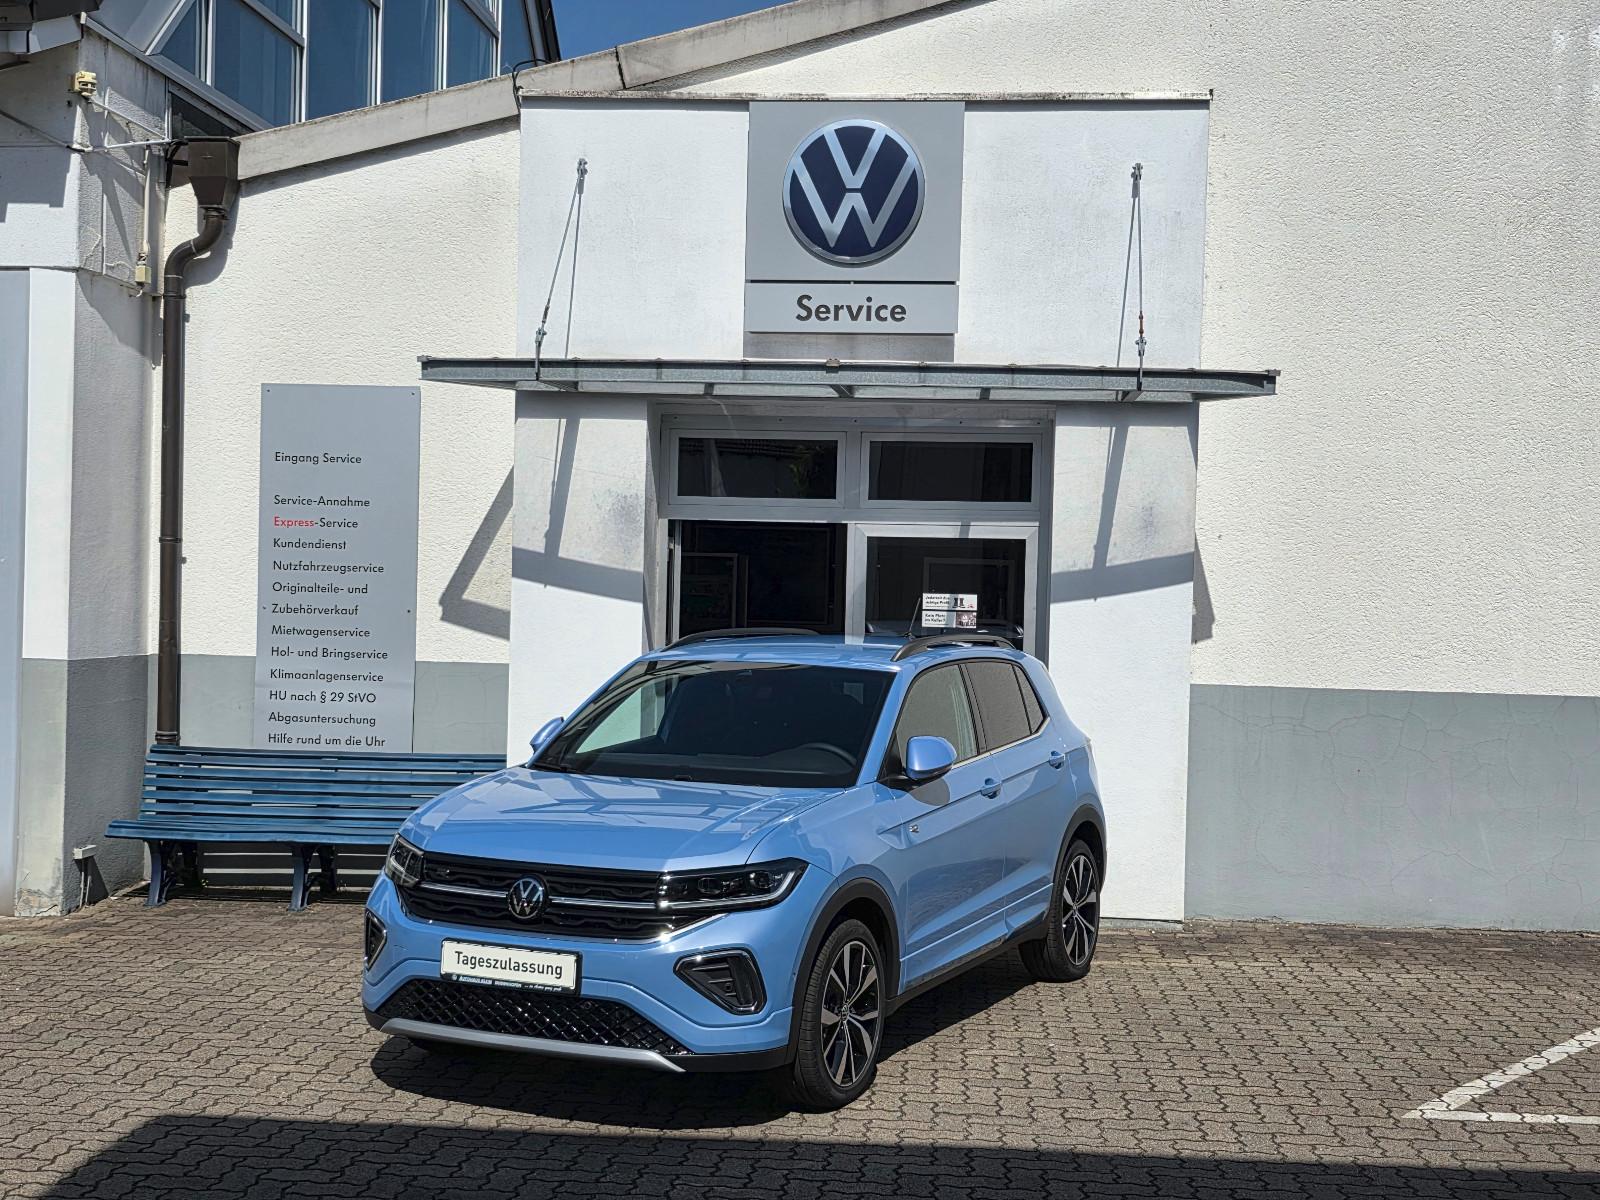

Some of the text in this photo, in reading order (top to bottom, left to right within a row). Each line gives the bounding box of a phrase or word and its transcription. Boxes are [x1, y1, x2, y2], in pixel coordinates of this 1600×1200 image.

[787, 123, 921, 255] VW
[795, 293, 907, 322] Service
[274, 452, 362, 465] Eingang Service
[273, 495, 371, 507] Service-Annahme
[273, 516, 359, 529] Express-Service
[273, 538, 347, 550] Kundendienst
[273, 561, 385, 575] Nutzfahrzeugservice
[272, 582, 369, 594] Originalteile- und
[271, 603, 360, 616] Zubehörverkauf
[271, 625, 371, 638] Mietwagenservice
[271, 646, 388, 661] Hol- und Bringservice
[269, 668, 384, 683] Klimaanlagenservice
[269, 690, 377, 704] HU nach § 29 StVO
[268, 711, 376, 727] Abgasuntersuchung
[268, 733, 386, 747] Hilfe rund um die Uhr
[454, 950, 563, 980] Tageszulassung
